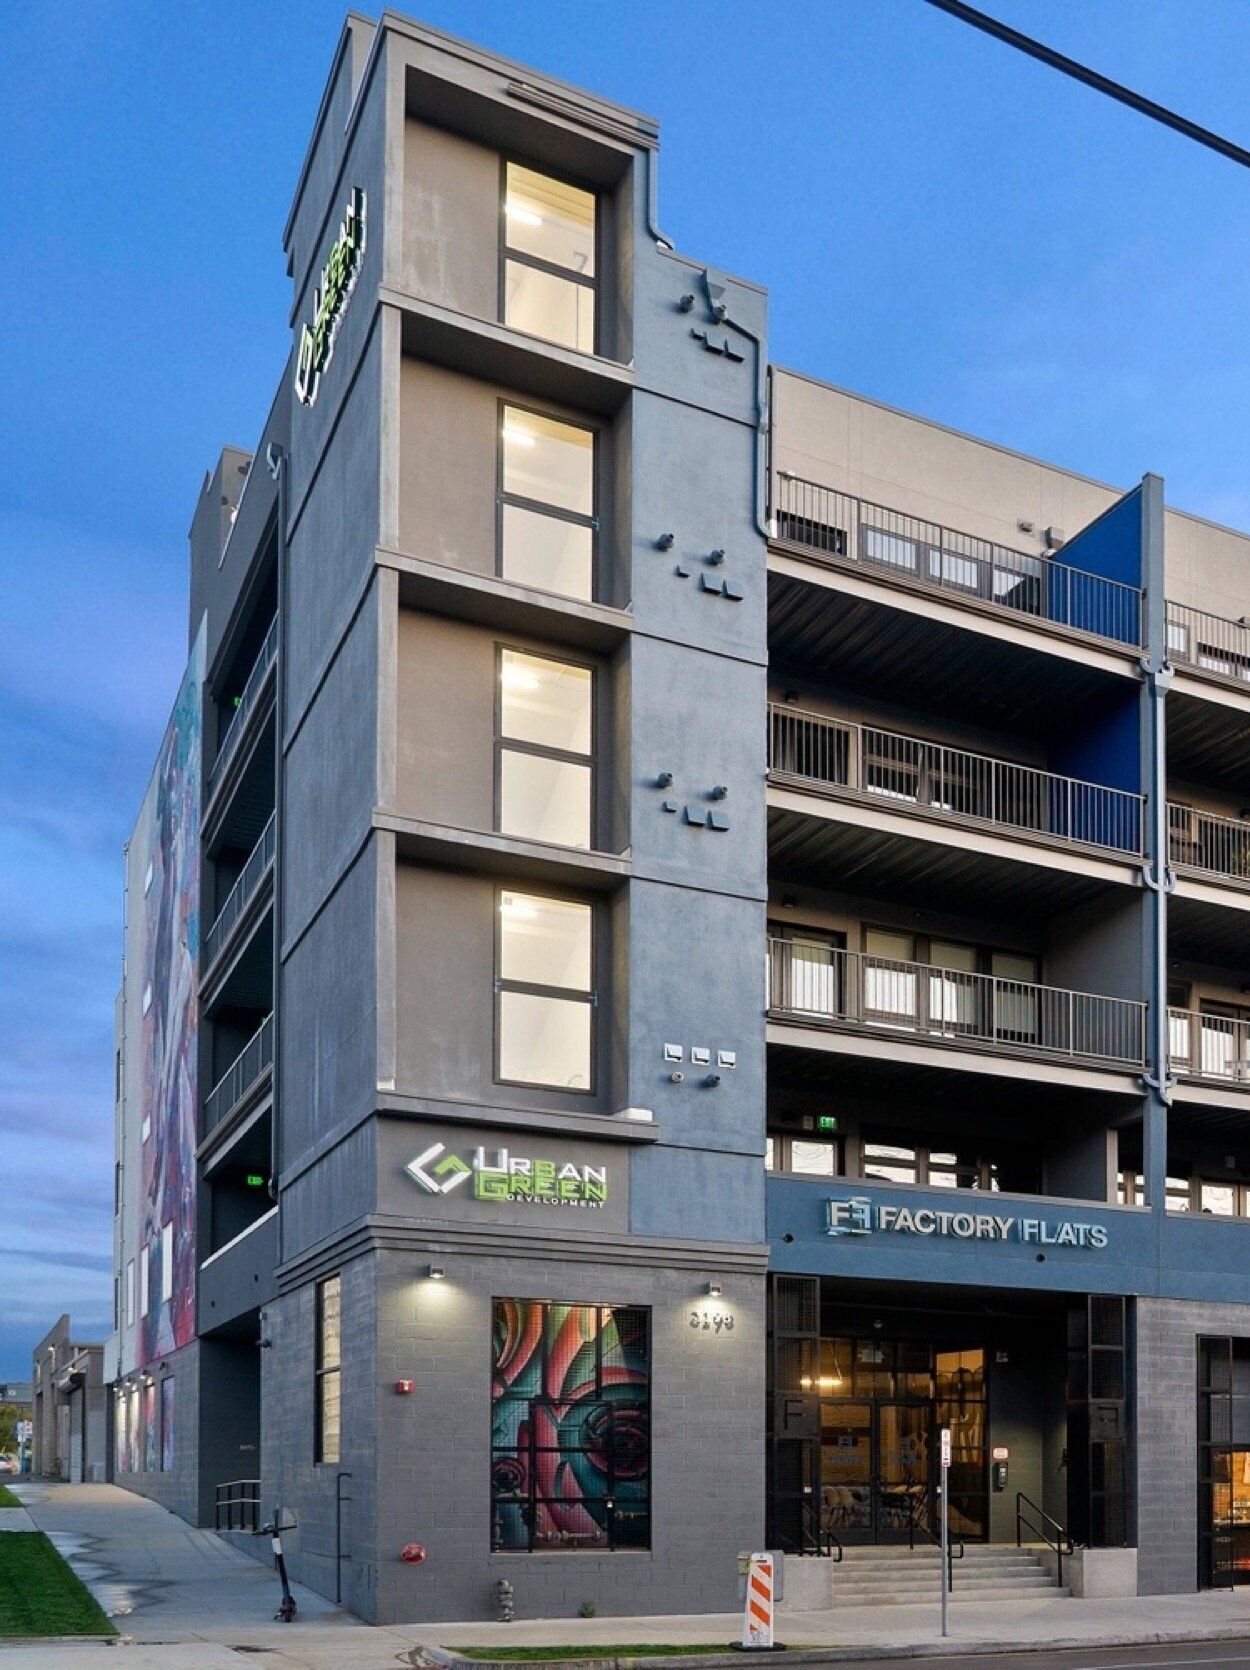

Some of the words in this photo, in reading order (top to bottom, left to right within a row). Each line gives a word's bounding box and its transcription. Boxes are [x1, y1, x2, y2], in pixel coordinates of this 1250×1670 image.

[474, 1146, 606, 1183] URBAN
[476, 1170, 607, 1201] GREEN
[506, 1192, 604, 1209] DEVELOPMENT
[877, 1206, 1014, 1239] FACTORY
[1019, 1218, 1109, 1249] FLATS
